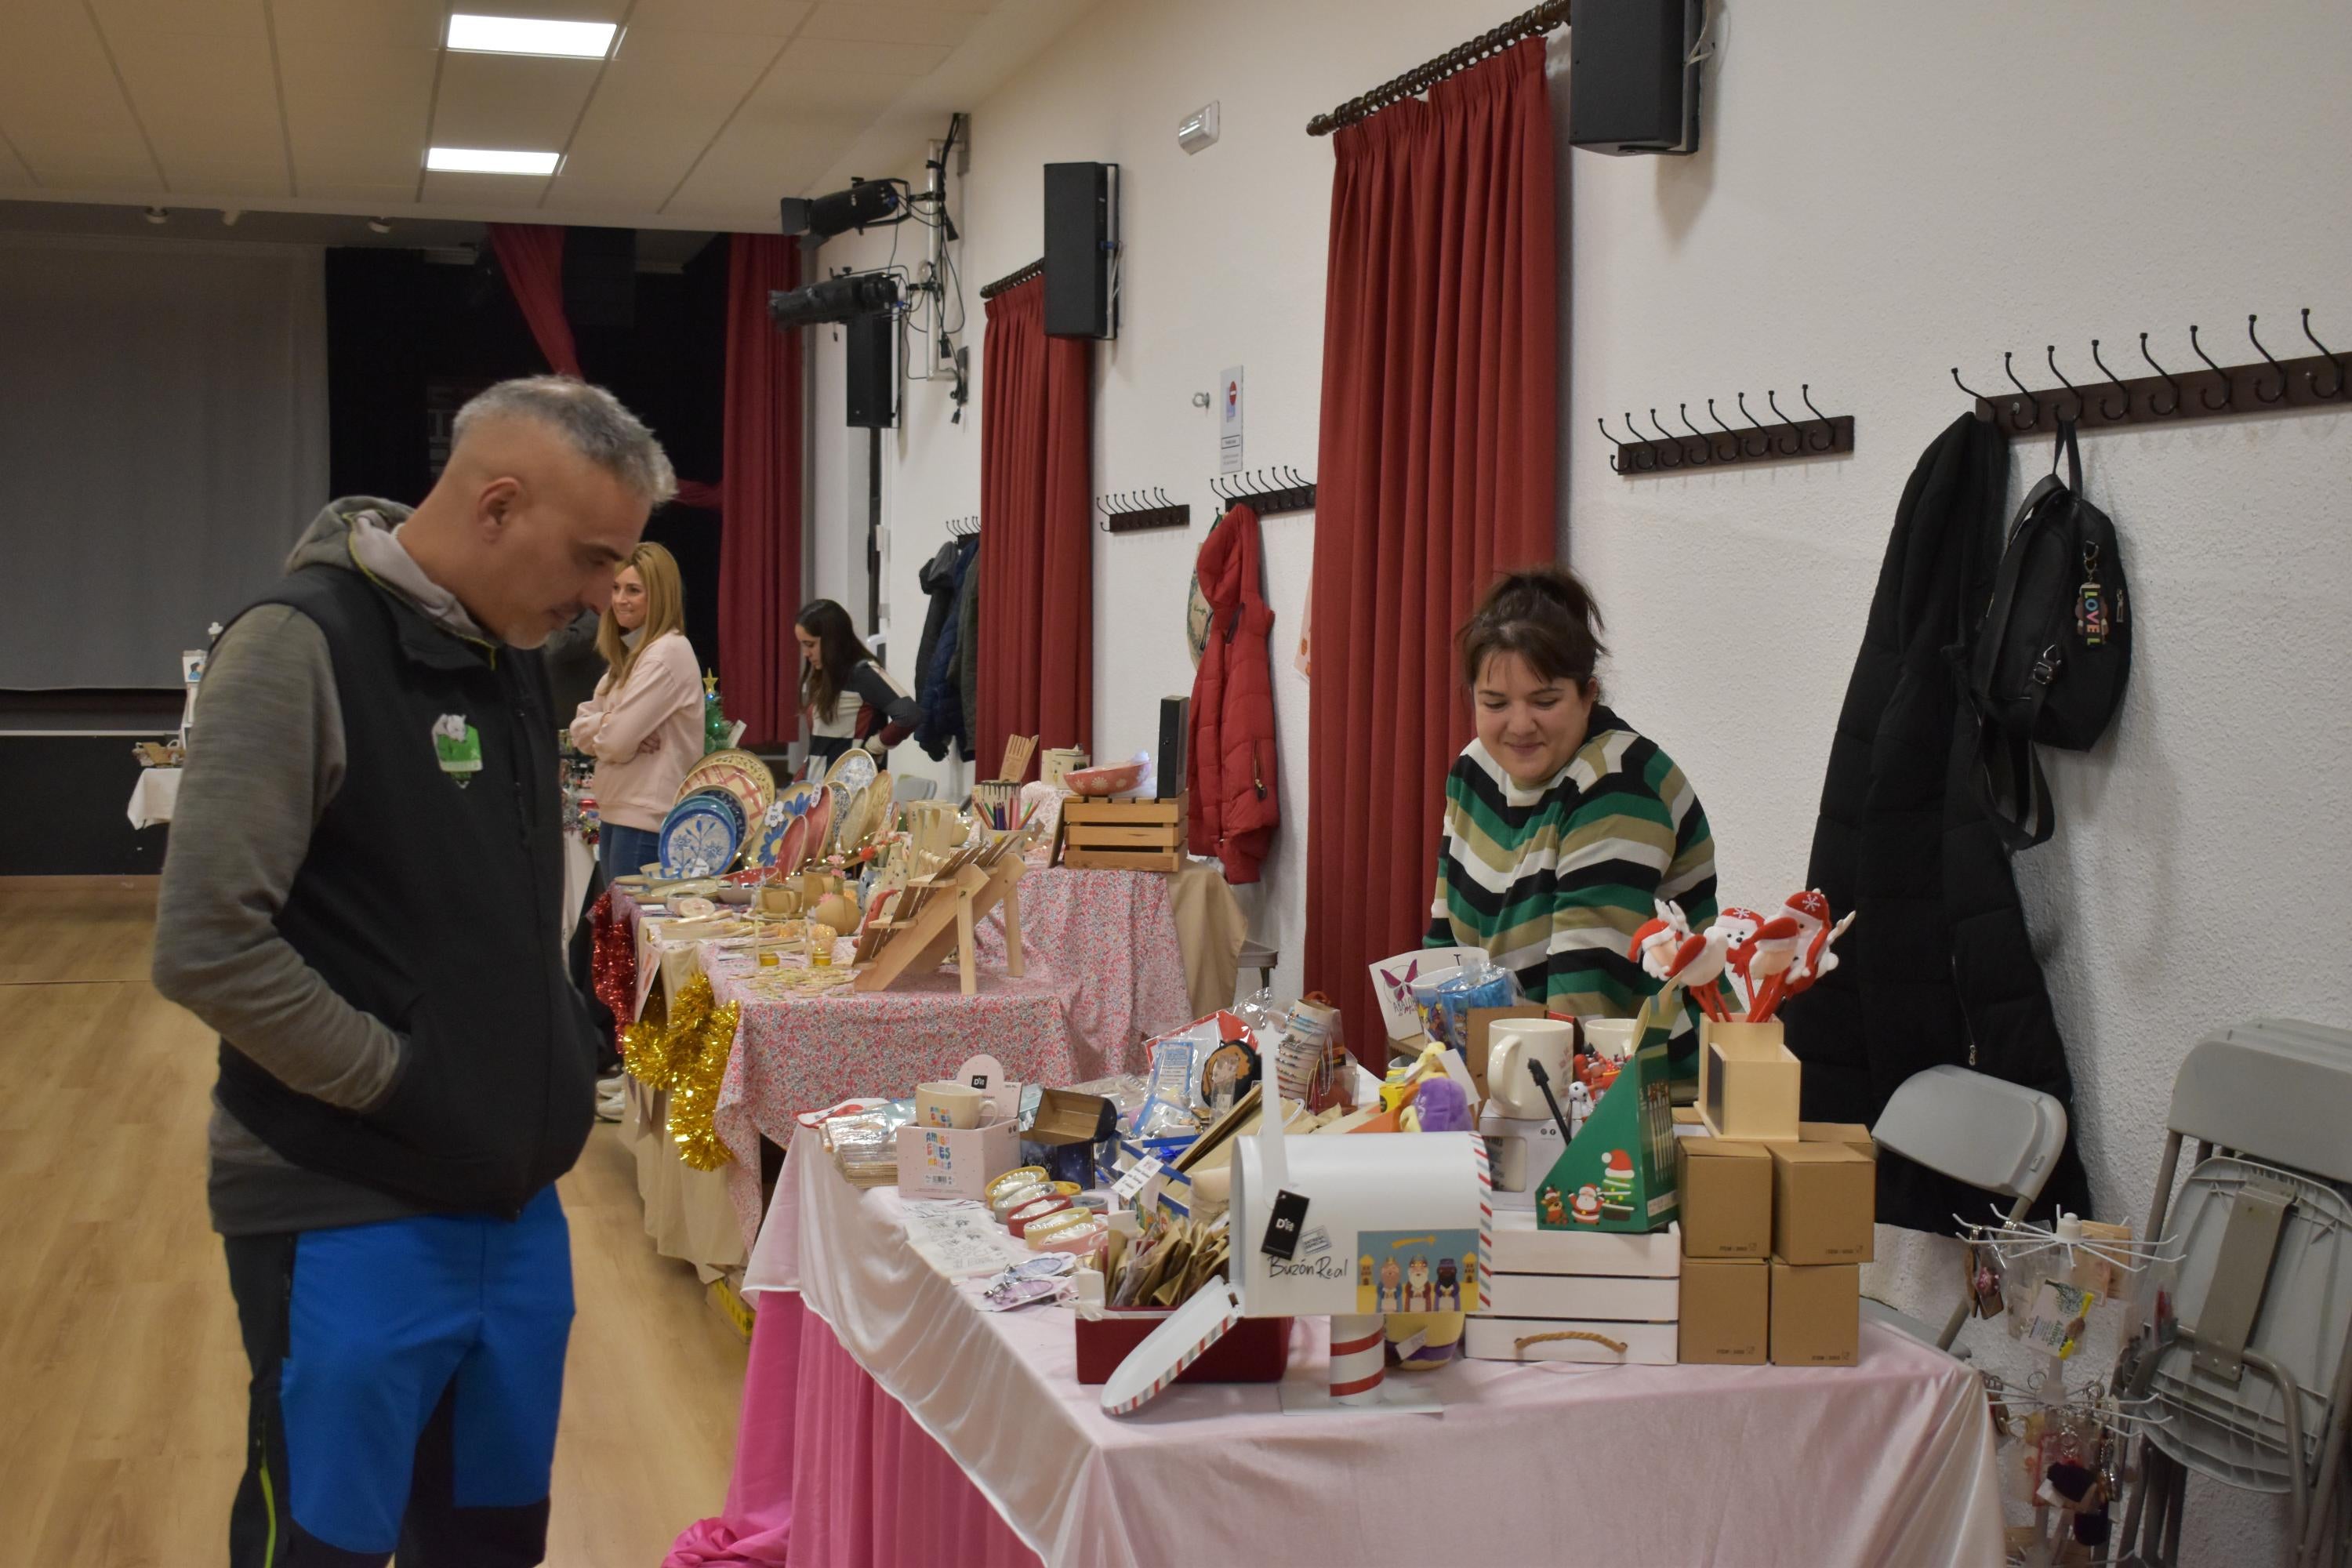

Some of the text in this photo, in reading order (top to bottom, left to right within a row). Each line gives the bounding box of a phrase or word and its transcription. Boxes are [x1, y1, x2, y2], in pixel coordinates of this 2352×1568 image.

[2085, 591, 2100, 633] LOVE
[1268, 1255, 1348, 1279] Buzón Real
